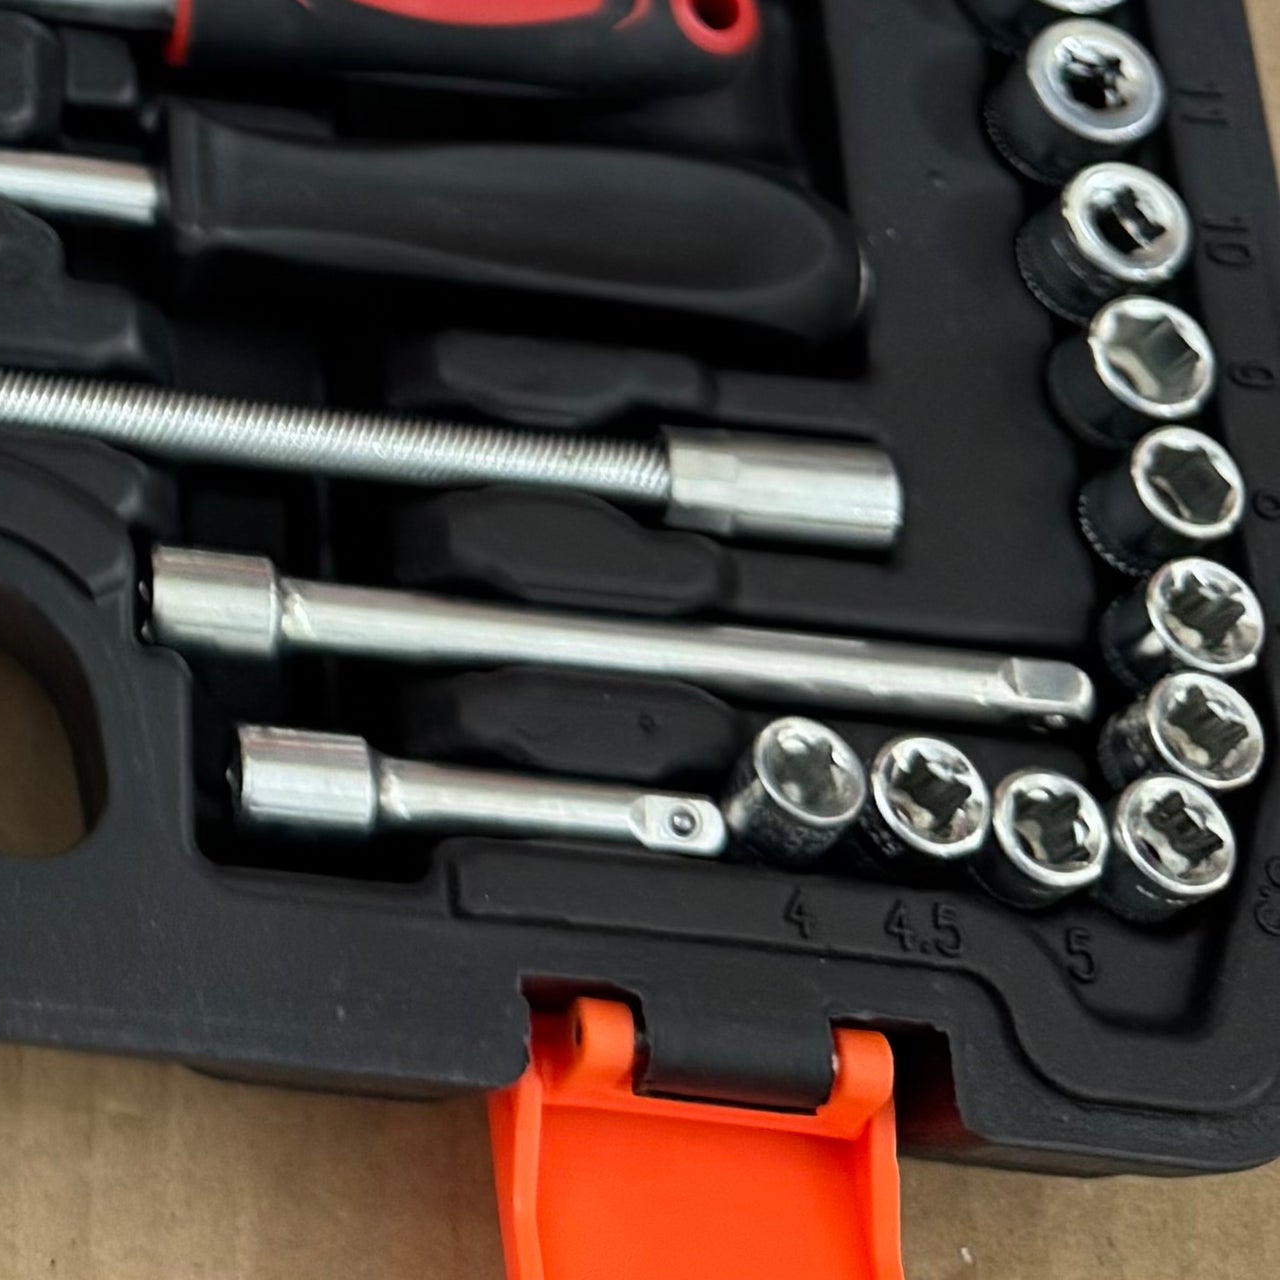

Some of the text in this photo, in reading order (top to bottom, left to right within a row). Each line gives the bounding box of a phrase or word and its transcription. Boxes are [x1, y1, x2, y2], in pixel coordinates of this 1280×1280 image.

[1201, 215, 1253, 269] 10
[783, 886, 818, 940] 4
[884, 897, 966, 959] 4.5
[1064, 925, 1099, 985] 5
